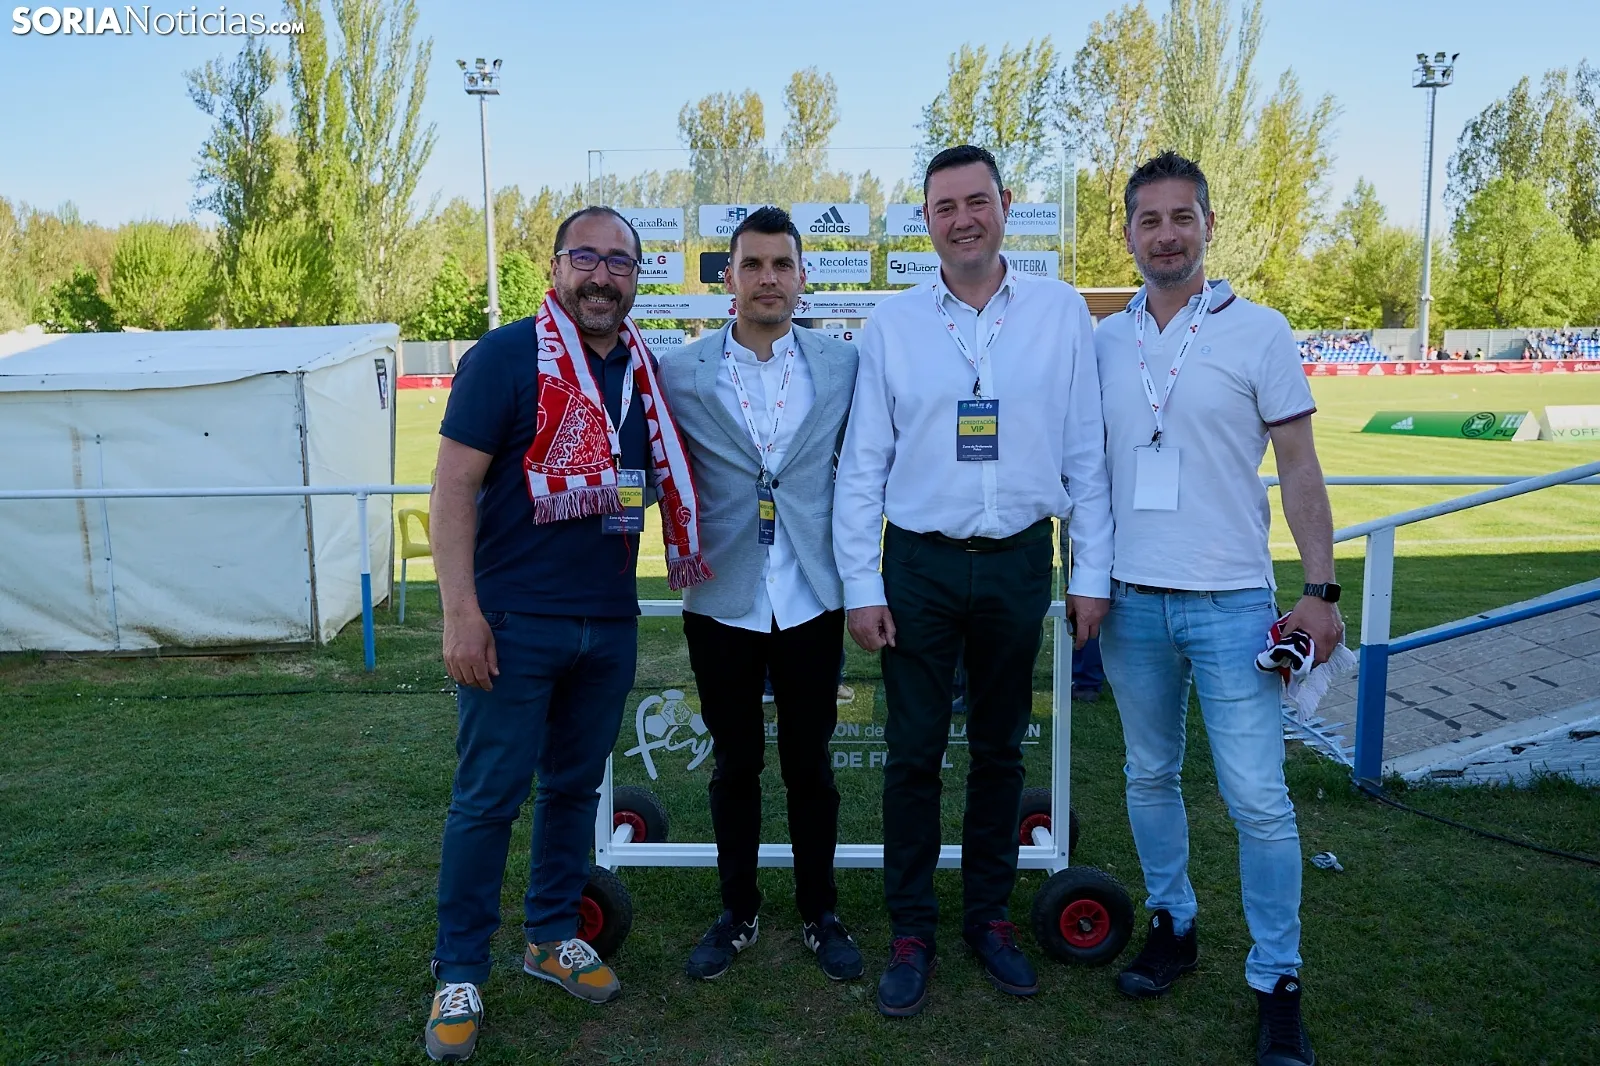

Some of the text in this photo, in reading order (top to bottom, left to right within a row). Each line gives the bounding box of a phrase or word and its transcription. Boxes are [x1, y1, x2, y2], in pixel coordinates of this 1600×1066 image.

[1008, 209, 1057, 219] Recoletas
[630, 217, 678, 228] CaixaBank
[809, 221, 850, 233] adidas
[716, 225, 736, 234] GON
[657, 255, 667, 265] G
[820, 257, 868, 267] Recoletas
[643, 335, 682, 345] ecoletas
[833, 752, 862, 768] DE
